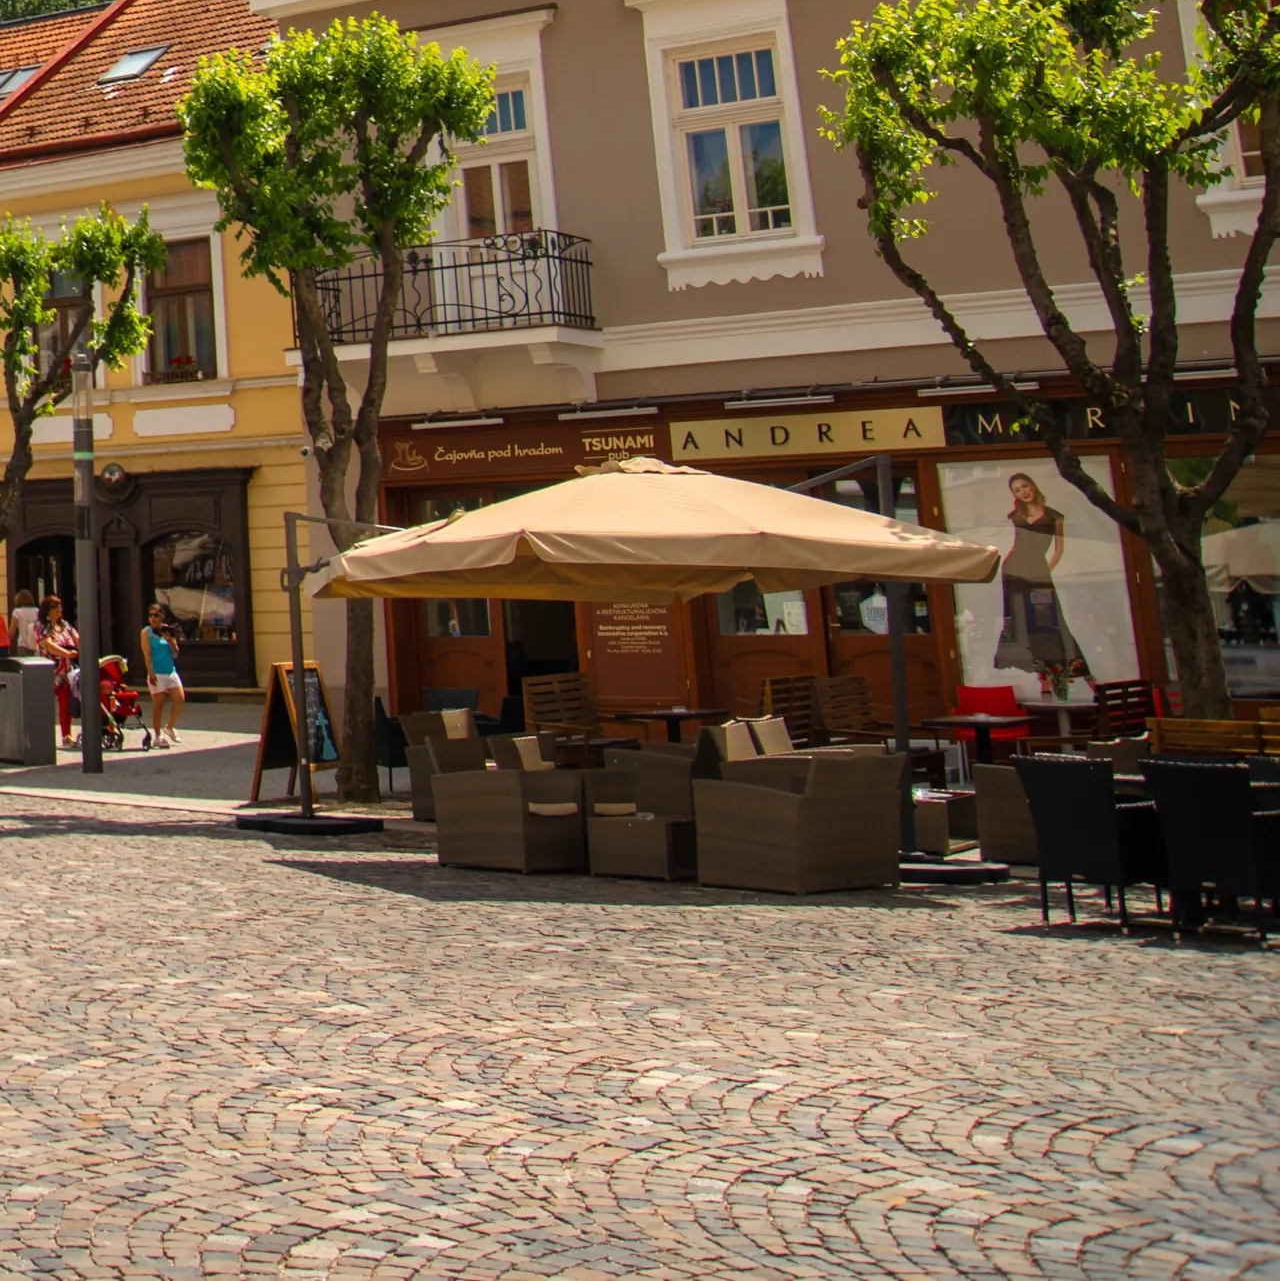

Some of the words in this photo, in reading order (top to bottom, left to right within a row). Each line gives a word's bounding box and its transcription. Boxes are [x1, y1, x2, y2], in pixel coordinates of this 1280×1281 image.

[681, 417, 922, 451] ANDREA
[977, 399, 1240, 435] MRI
[582, 434, 655, 452] TSUNAMI
[433, 445, 486, 465] Čajovňa
[488, 445, 512, 462] pod
[514, 442, 564, 458] hradom
[608, 450, 630, 462] pub
